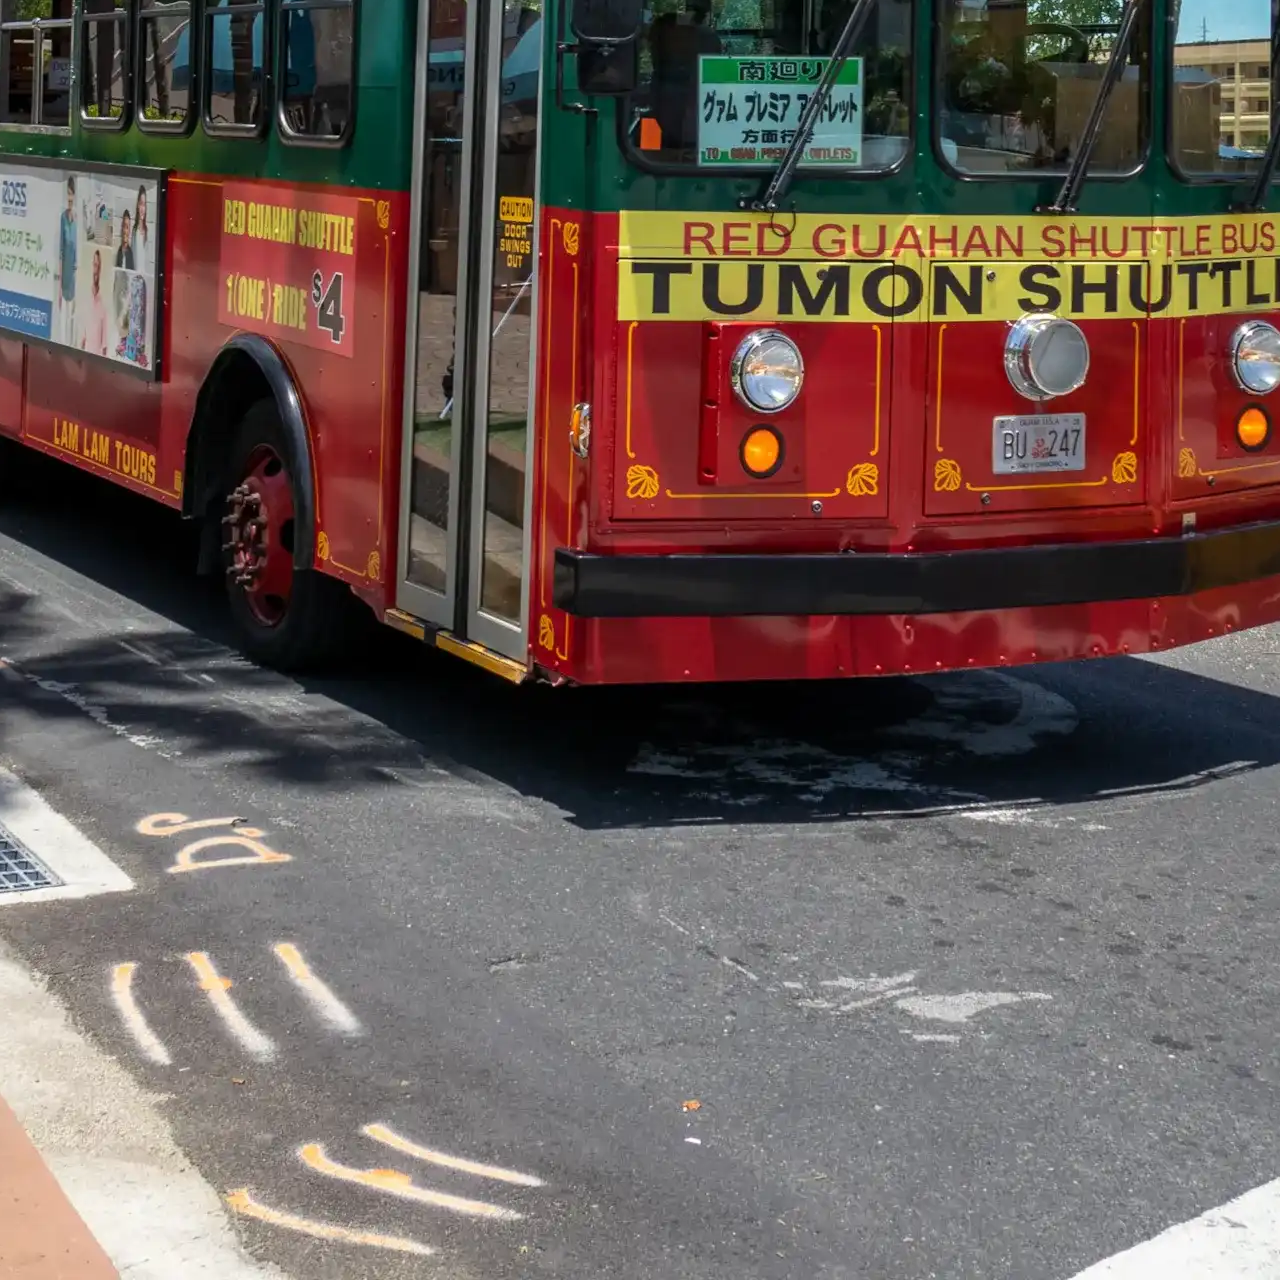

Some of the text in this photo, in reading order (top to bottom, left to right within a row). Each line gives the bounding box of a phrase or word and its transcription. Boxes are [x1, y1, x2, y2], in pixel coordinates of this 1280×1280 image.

[2, 181, 27, 207] ROSS
[501, 201, 532, 218] CAUTION
[224, 199, 355, 255] RED GUAHAN SHUTTLE
[504, 224, 527, 238] DOOR
[683, 221, 1276, 259] RED GUAHAN SHUTTLE BUS
[500, 238, 531, 254] SWINGS
[506, 253, 523, 268] OUT
[631, 261, 983, 318] TUMON
[272, 283, 308, 330] RIDE
[54, 417, 79, 452] LAM
[83, 428, 110, 465] LAM
[115, 440, 157, 485] TOURS
[1003, 429, 1081, 460] BU 247
